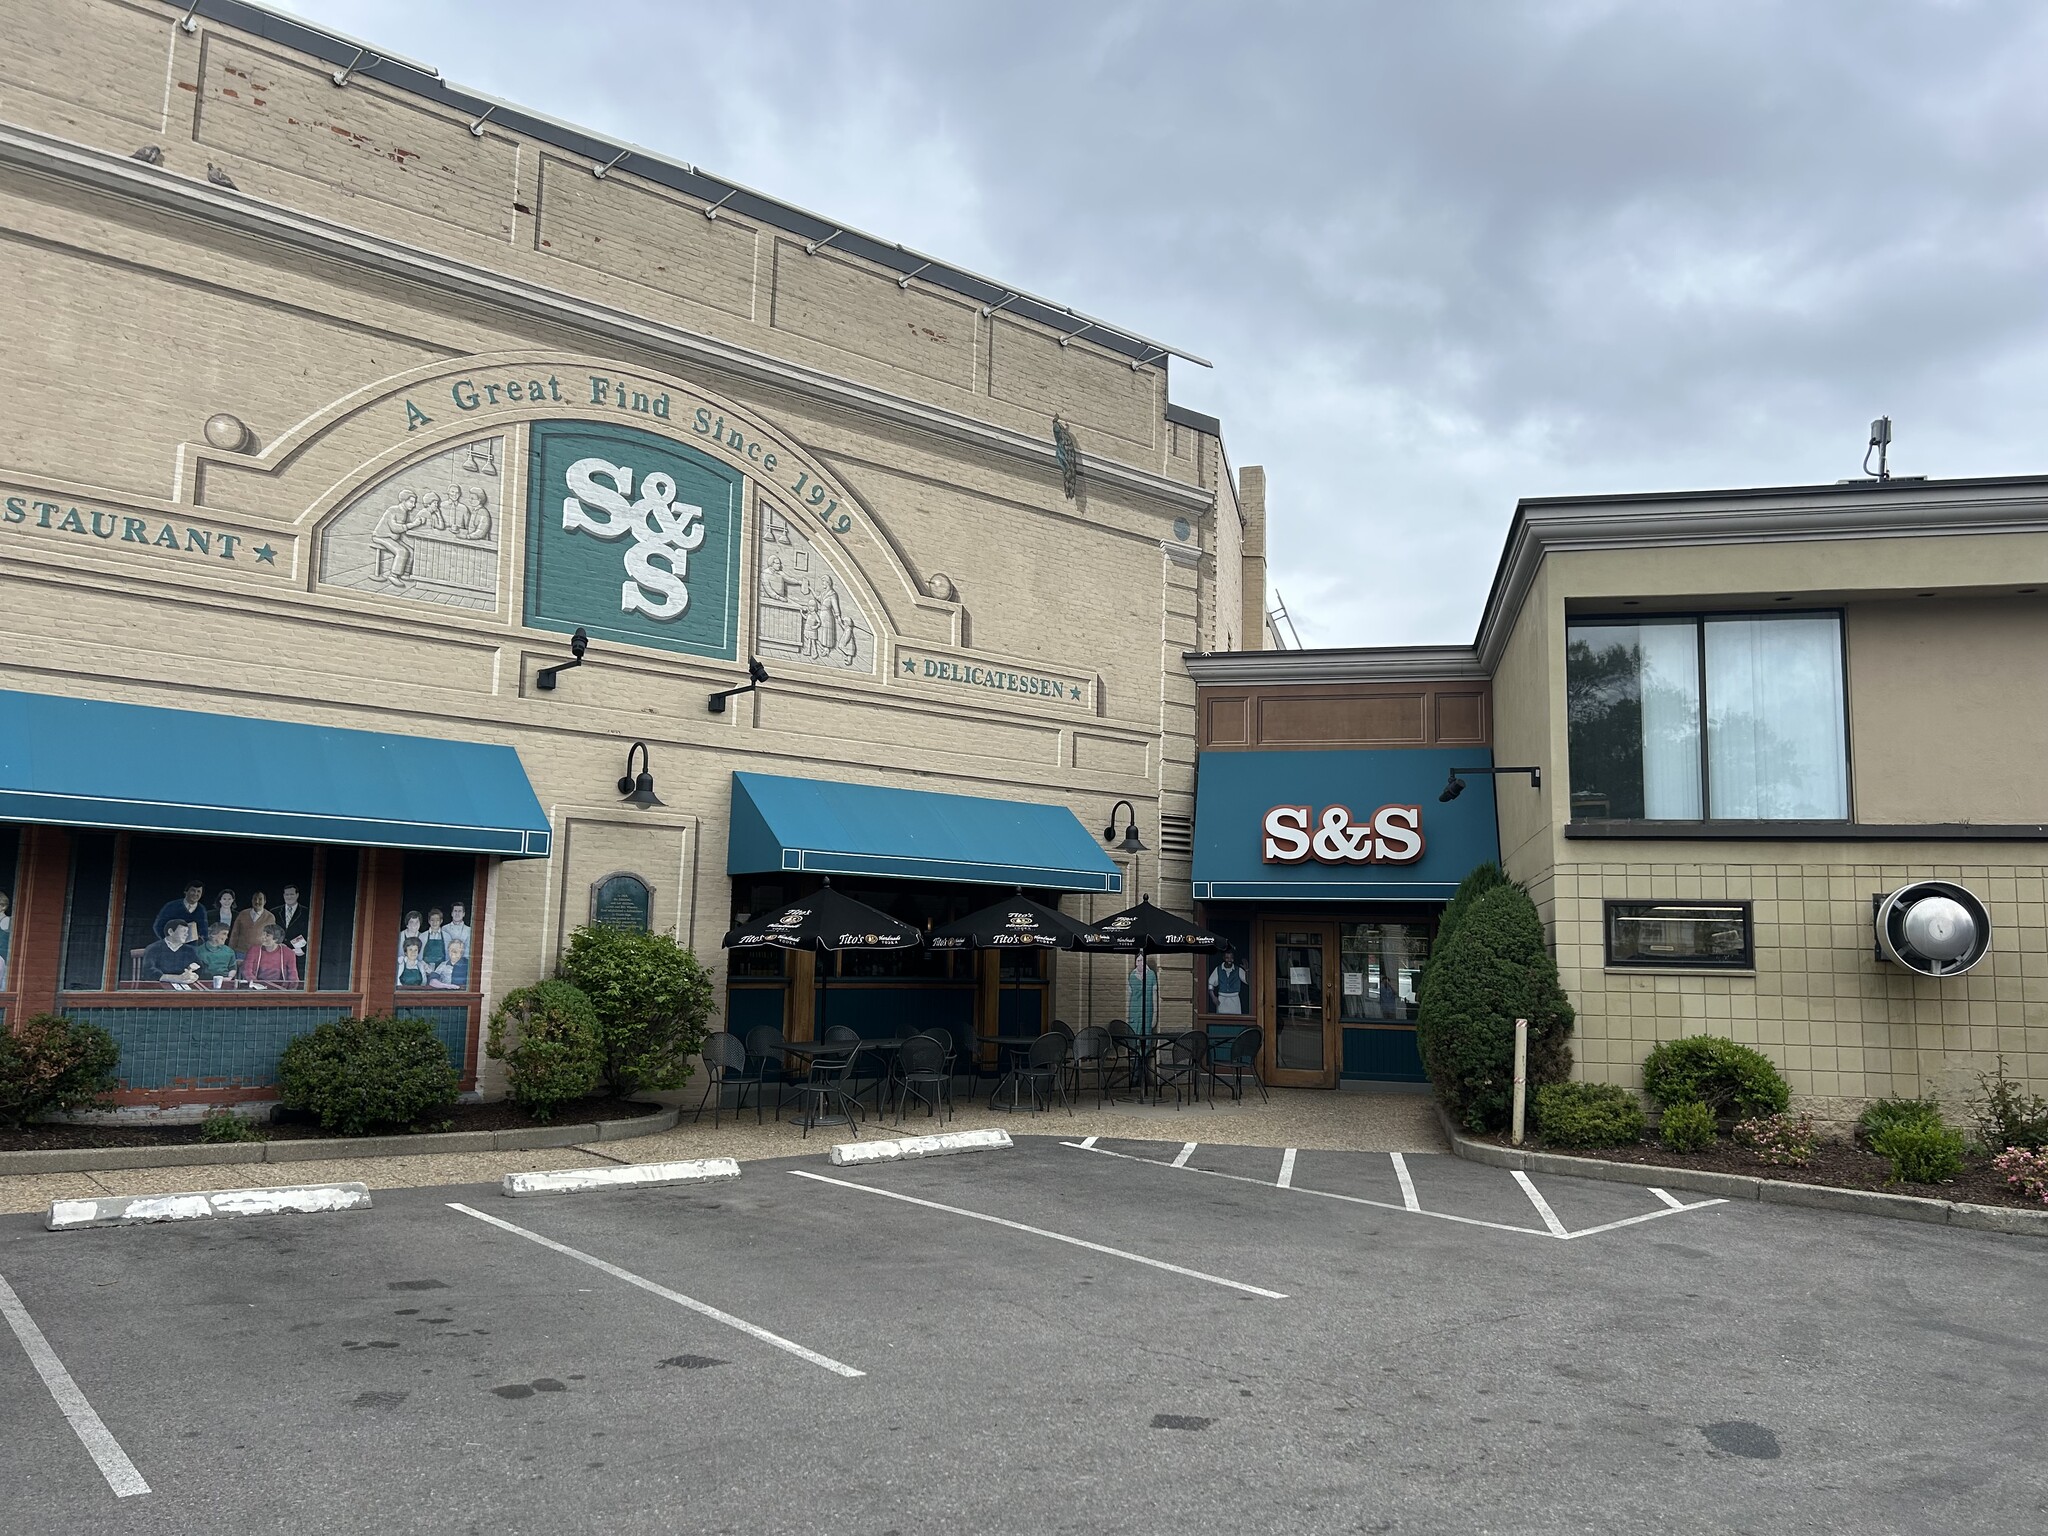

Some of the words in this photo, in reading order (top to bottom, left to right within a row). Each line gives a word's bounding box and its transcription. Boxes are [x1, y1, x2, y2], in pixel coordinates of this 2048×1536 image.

[406, 399, 434, 431] A
[452, 374, 562, 411] Great
[589, 375, 671, 420] Find
[692, 407, 778, 472] Since
[791, 471, 852, 535] 1919
[3, 496, 242, 561] STAURANT
[924, 658, 1064, 699] DELICATESSEN
[1264, 806, 1423, 862] S&S
[838, 933, 865, 945] Tito's
[993, 934, 1020, 944] Tito's
